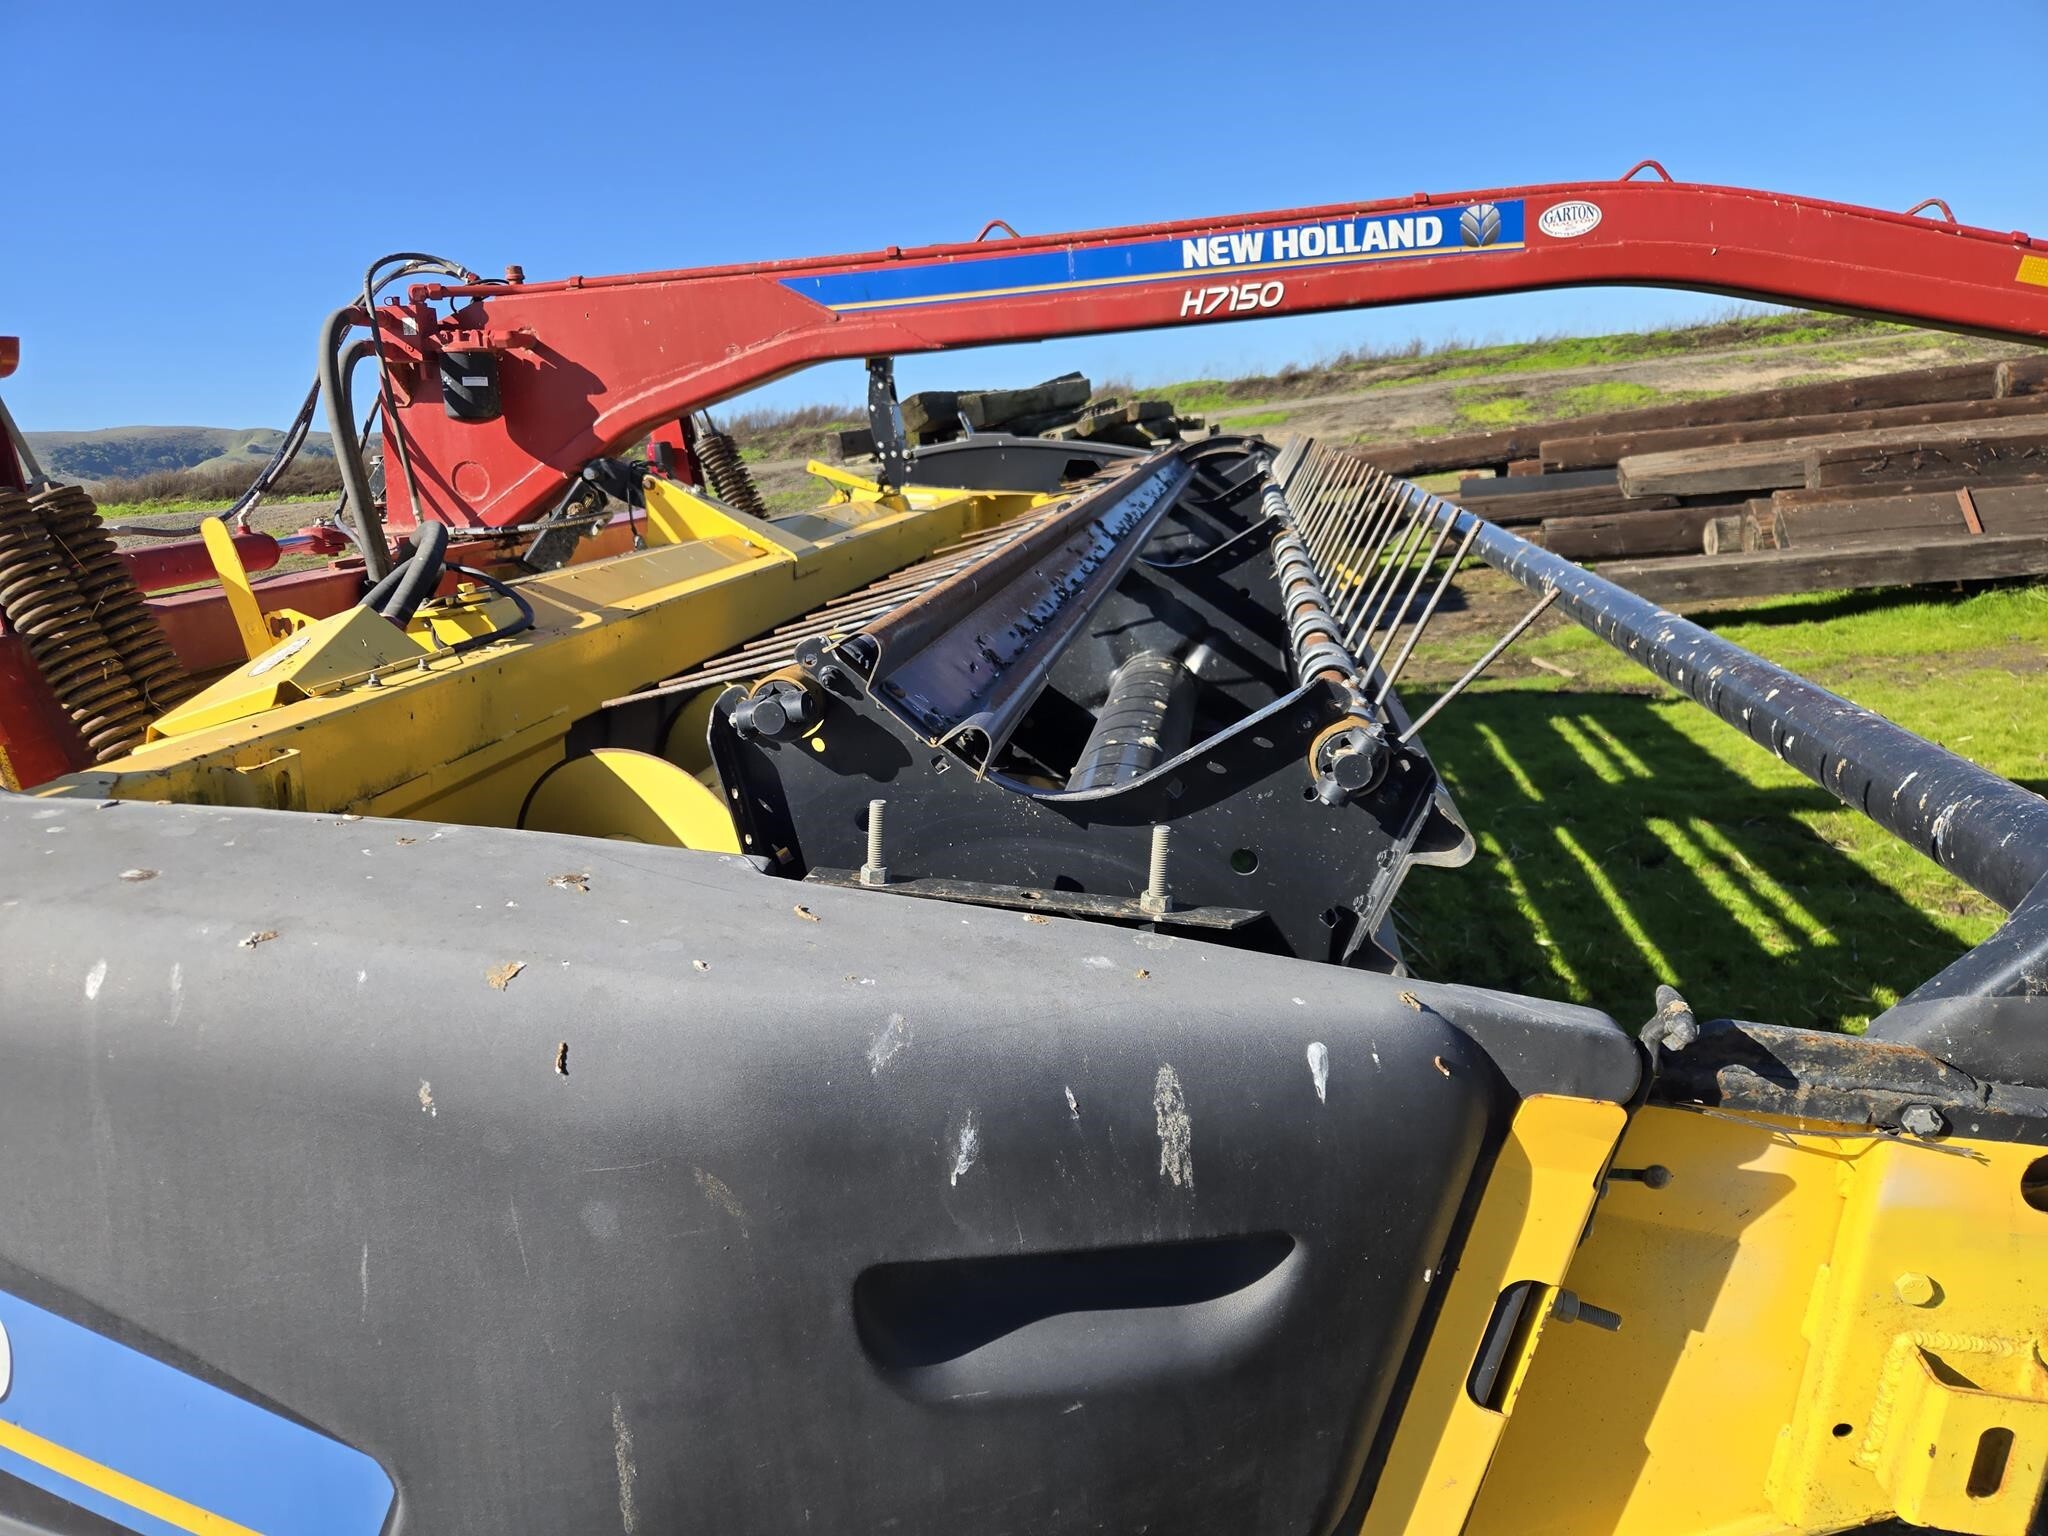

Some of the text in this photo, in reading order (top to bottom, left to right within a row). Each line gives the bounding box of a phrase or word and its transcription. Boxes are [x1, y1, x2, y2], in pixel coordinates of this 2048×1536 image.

[1544, 205, 1594, 224] GARTON
[1182, 215, 1443, 269] NEW HOLLAND
[1180, 281, 1285, 317] H7150
